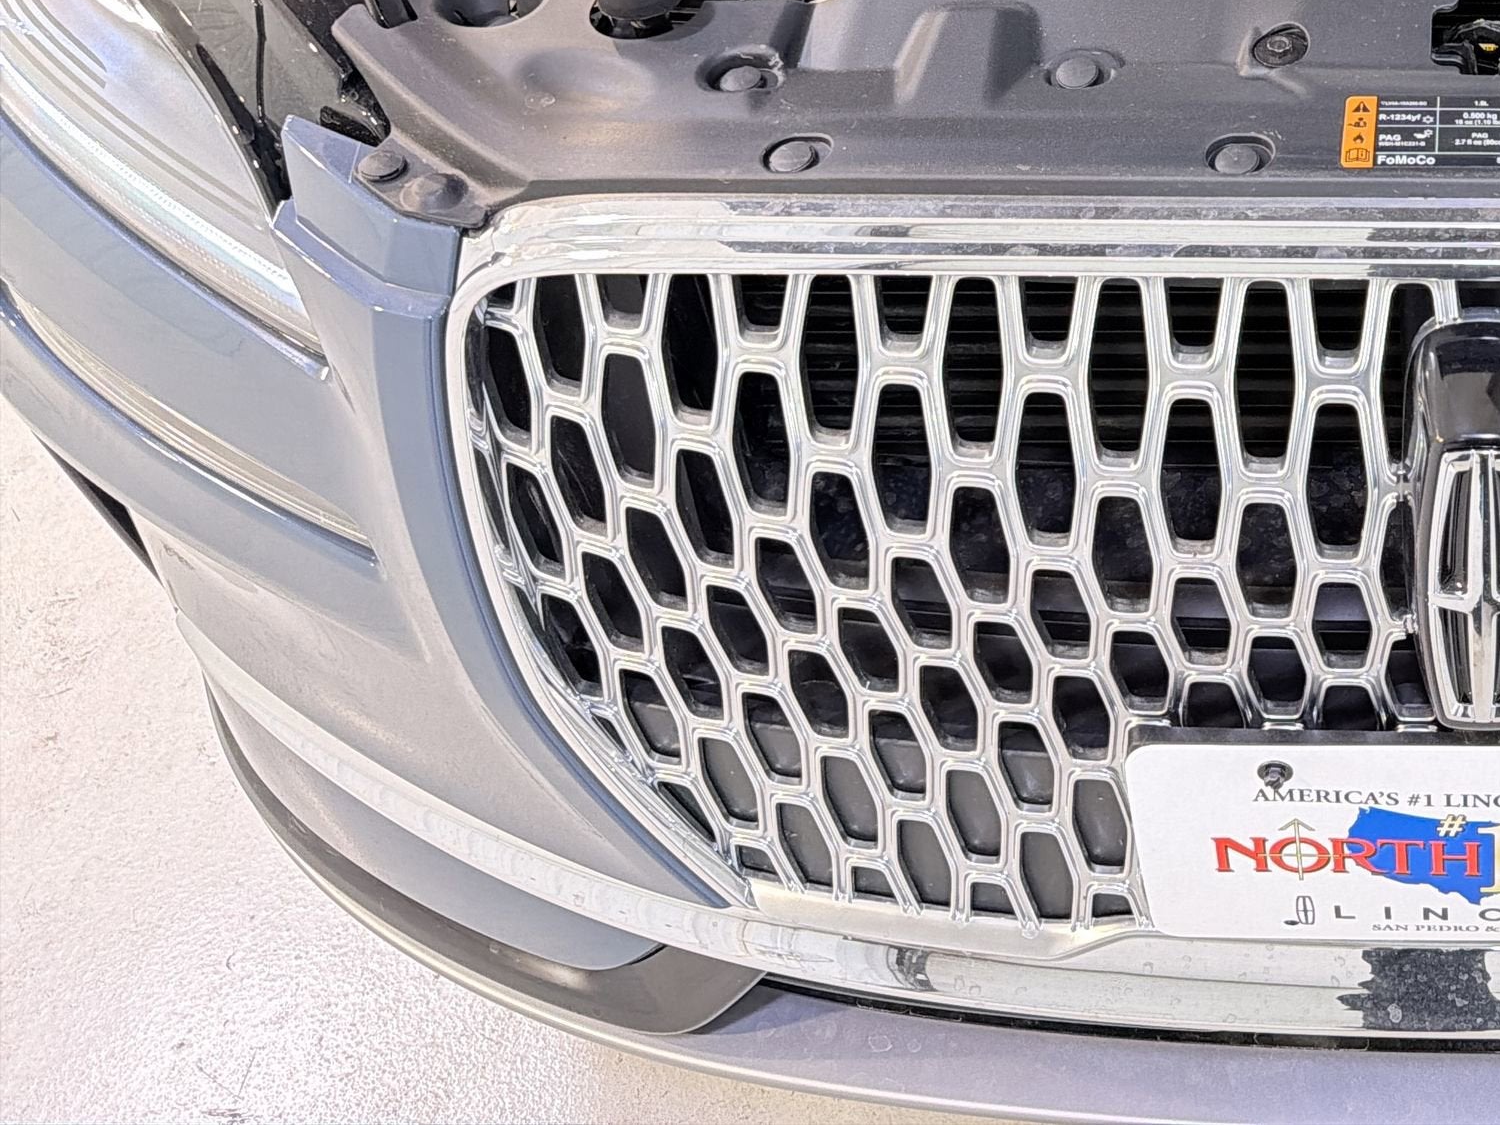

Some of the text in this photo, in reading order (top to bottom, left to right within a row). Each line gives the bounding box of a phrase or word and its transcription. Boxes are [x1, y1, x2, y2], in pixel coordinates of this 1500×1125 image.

[1378, 113, 1422, 122] R-1234yf
[1487, 112, 1498, 121] kg
[1377, 155, 1436, 165] FoMoCo
[1253, 788, 1400, 806] AMERICA'S
[1407, 793, 1436, 808] #1
[1211, 836, 1484, 879] NORTH
[1371, 923, 1409, 932] SAN
[1415, 924, 1480, 933] PEDRO
[1484, 925, 1500, 933] &
